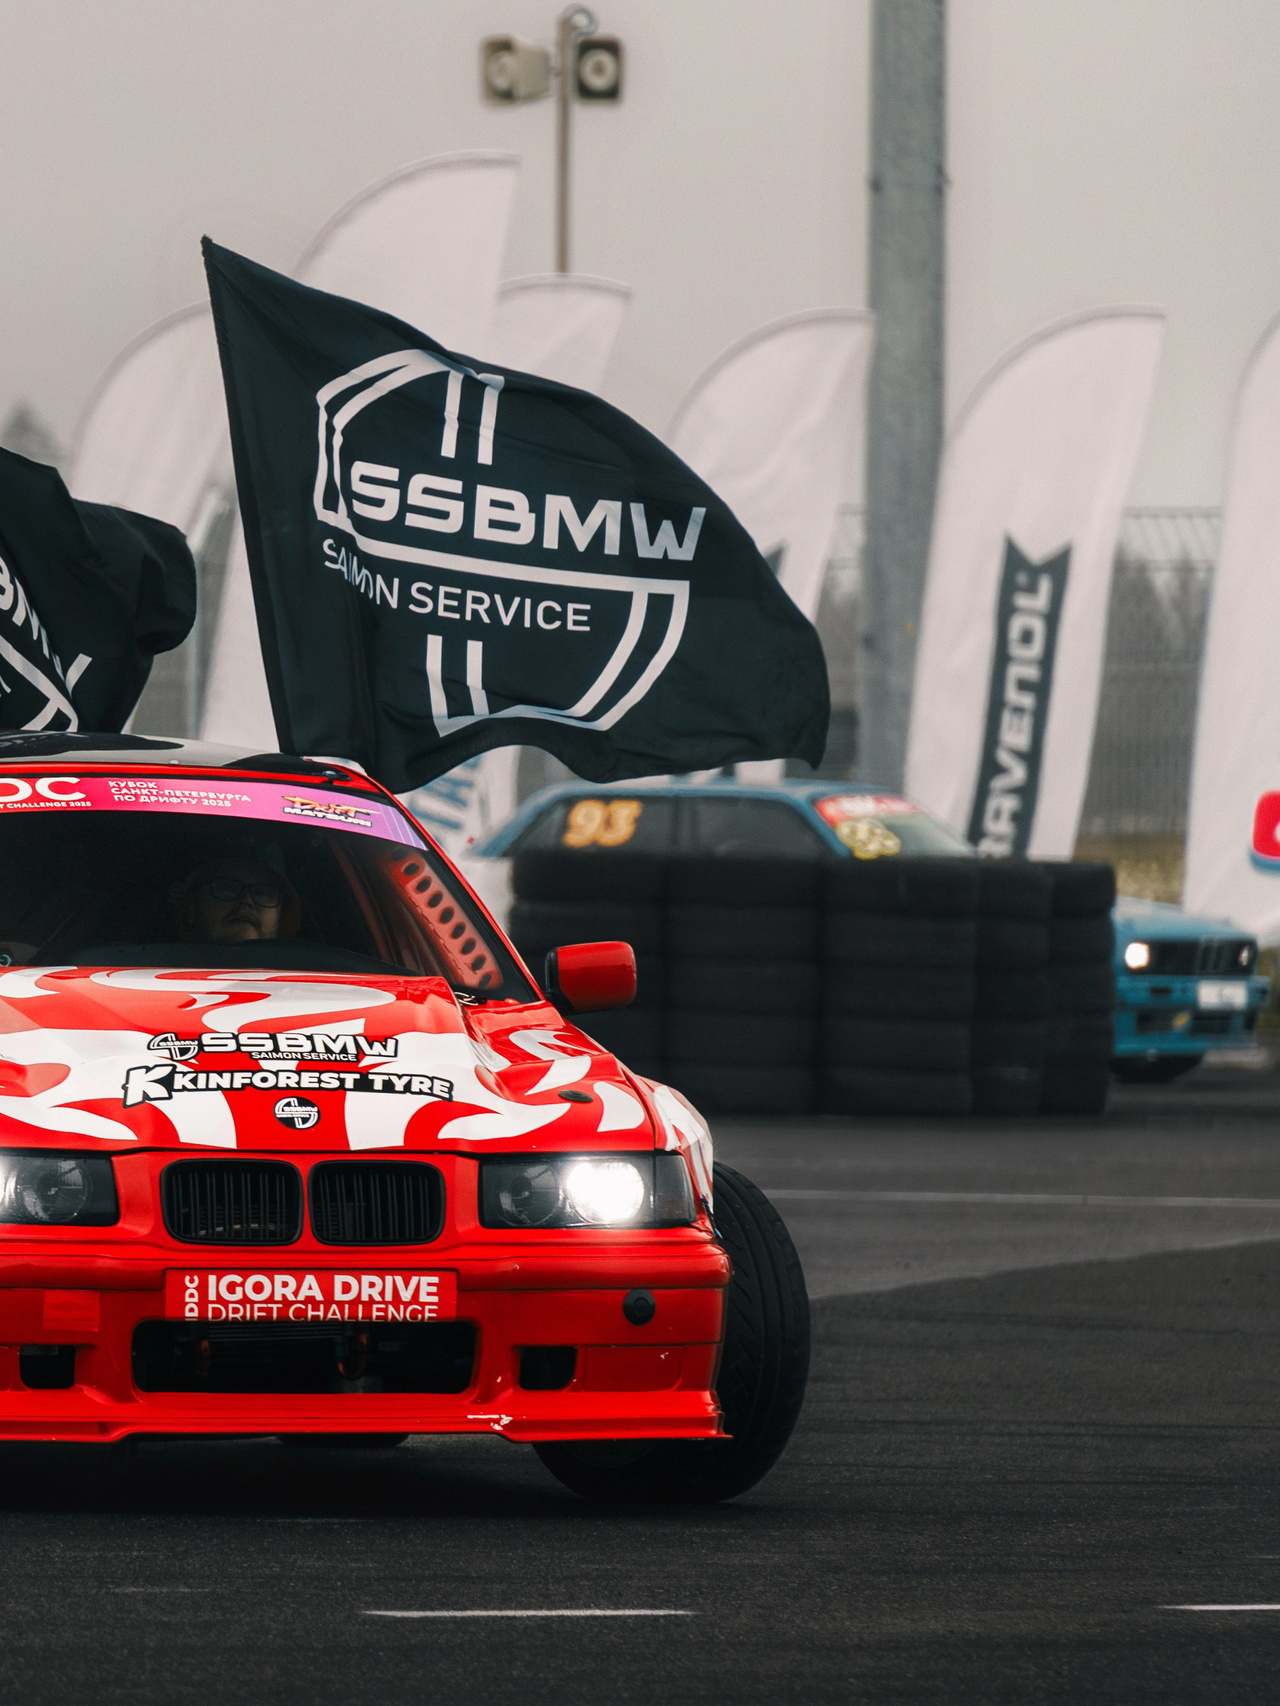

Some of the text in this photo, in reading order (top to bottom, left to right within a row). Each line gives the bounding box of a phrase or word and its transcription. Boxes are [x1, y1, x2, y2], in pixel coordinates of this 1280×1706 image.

[351, 459, 707, 562] SSBMW
[408, 582, 591, 632] SERVICE
[108, 780, 158, 788] КУБОК
[110, 787, 252, 802] САНКТ-ПЕТЕРБУРГА
[139, 795, 198, 805] ДРИФТУ
[6, 801, 68, 809] CHALLENGE
[201, 1032, 397, 1057] SSBMW
[251, 1051, 358, 1062] SAIMON SERVICE
[173, 1070, 361, 1091] KINFOREST
[368, 1073, 453, 1099] TYRE
[208, 1273, 440, 1303] IGORA DRIVE
[207, 1303, 439, 1323] DRIFT CHALLENGE
